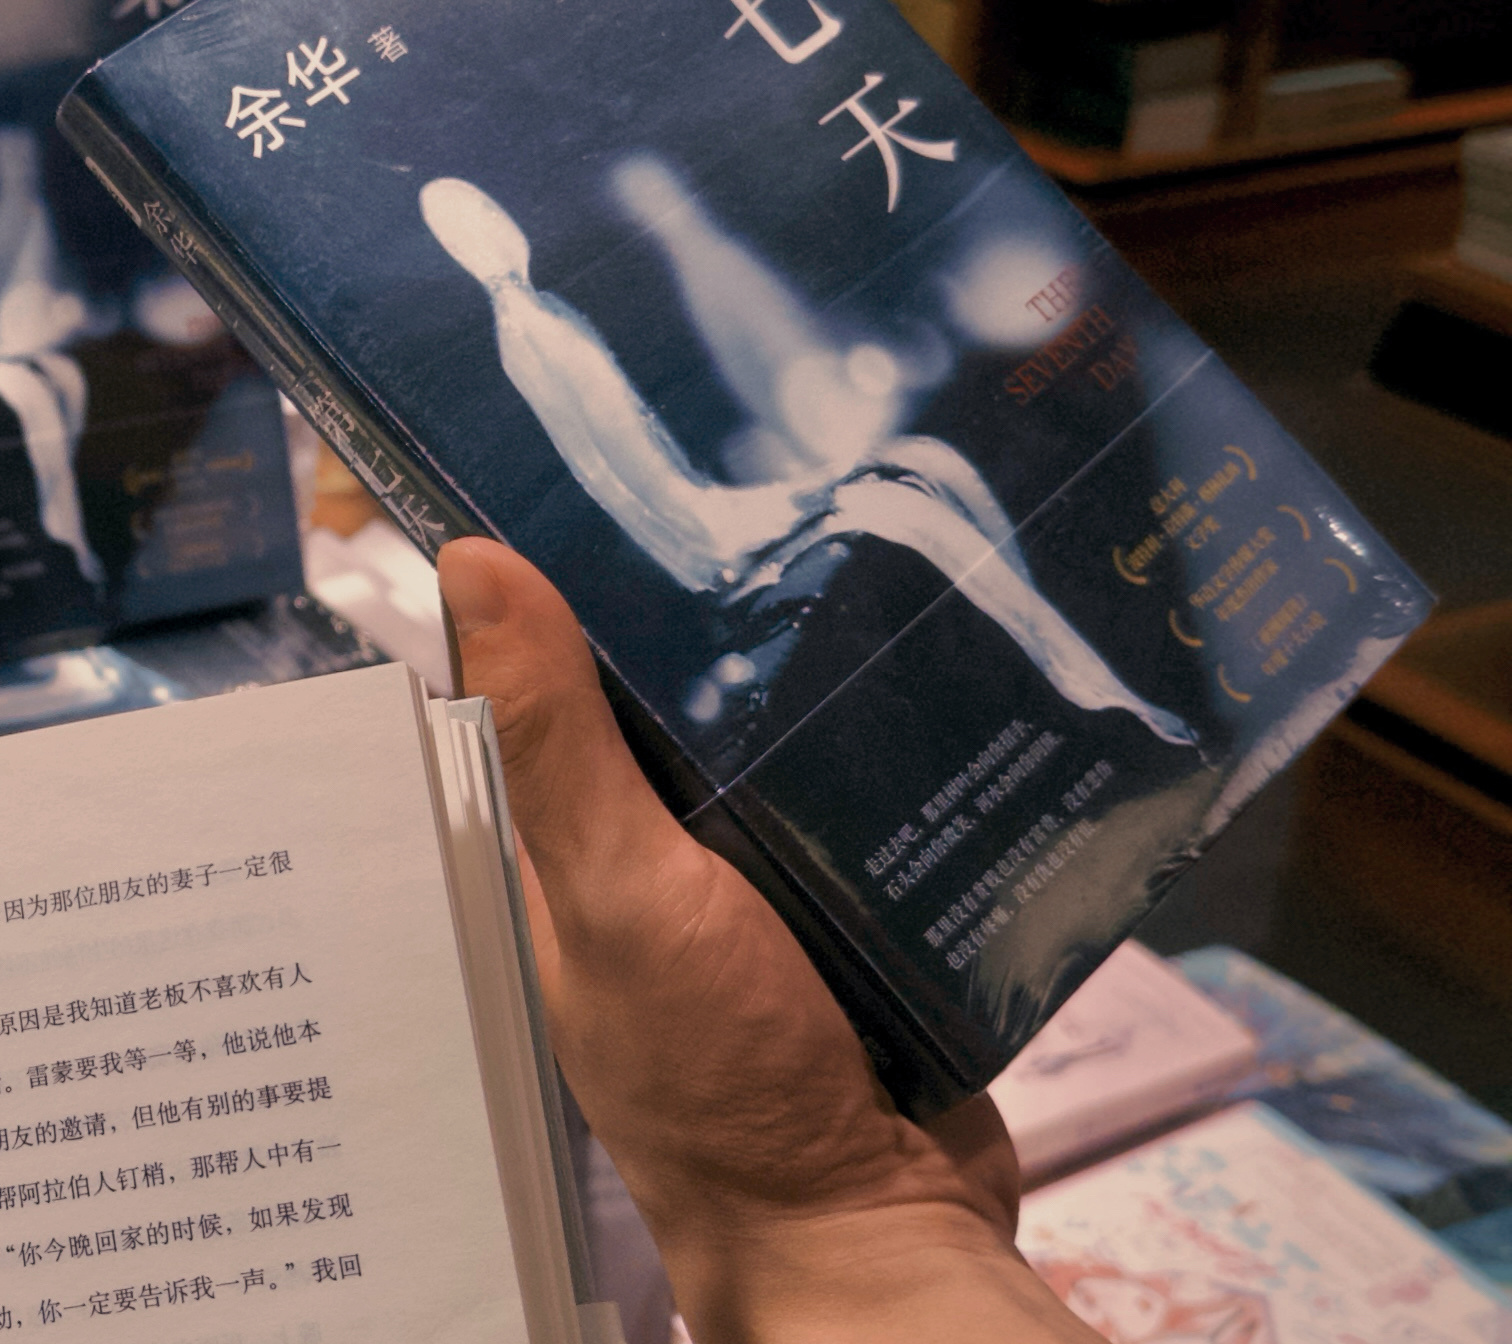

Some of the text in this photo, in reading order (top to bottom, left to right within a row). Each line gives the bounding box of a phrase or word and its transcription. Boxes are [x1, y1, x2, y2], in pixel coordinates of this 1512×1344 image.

[221, 27, 411, 160] 余华 著
[142, 201, 200, 267] 余华
[1004, 304, 1117, 406] SEVENTH
[304, 388, 447, 551] 第七天
